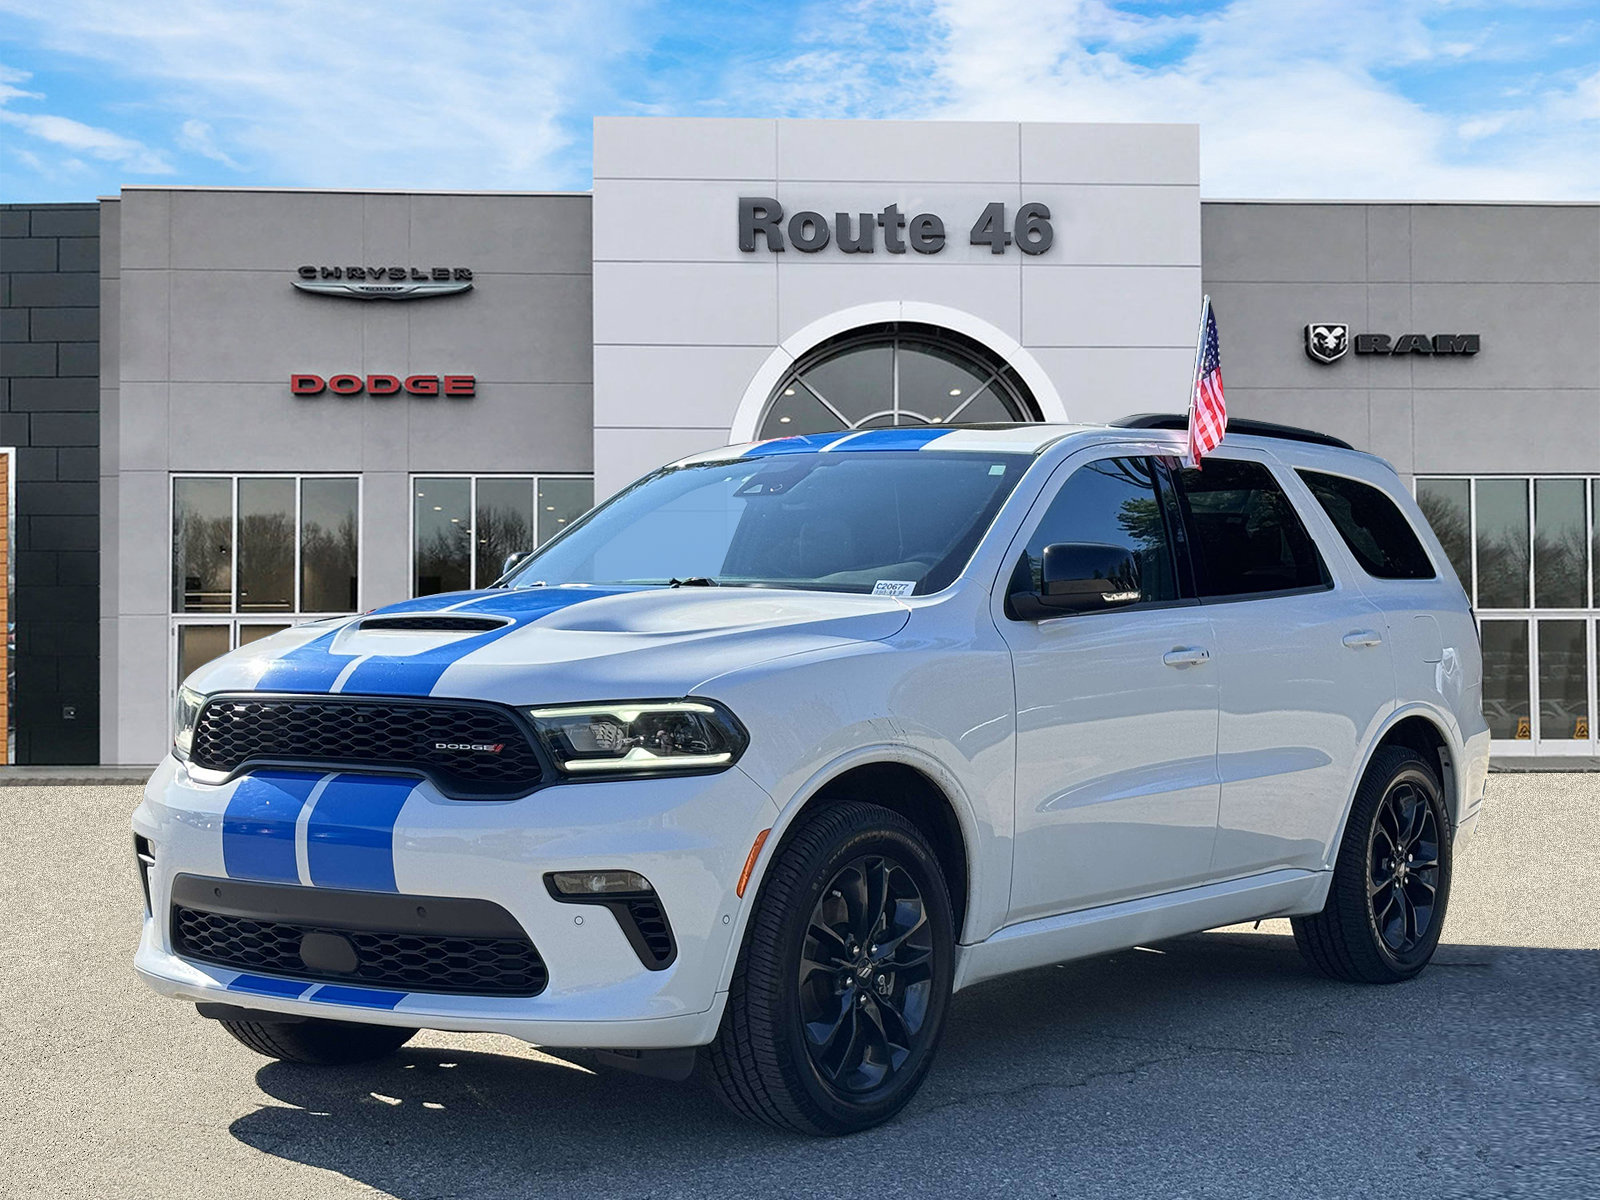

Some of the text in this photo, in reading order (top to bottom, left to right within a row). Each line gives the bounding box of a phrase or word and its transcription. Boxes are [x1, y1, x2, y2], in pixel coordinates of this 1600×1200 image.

[738, 196, 1055, 256] Route 46
[297, 265, 474, 281] CHRYSLER
[1353, 333, 1481, 356] RAM
[291, 373, 476, 397] DODGE
[876, 582, 909, 591] C20677
[435, 743, 495, 752] DODGE
